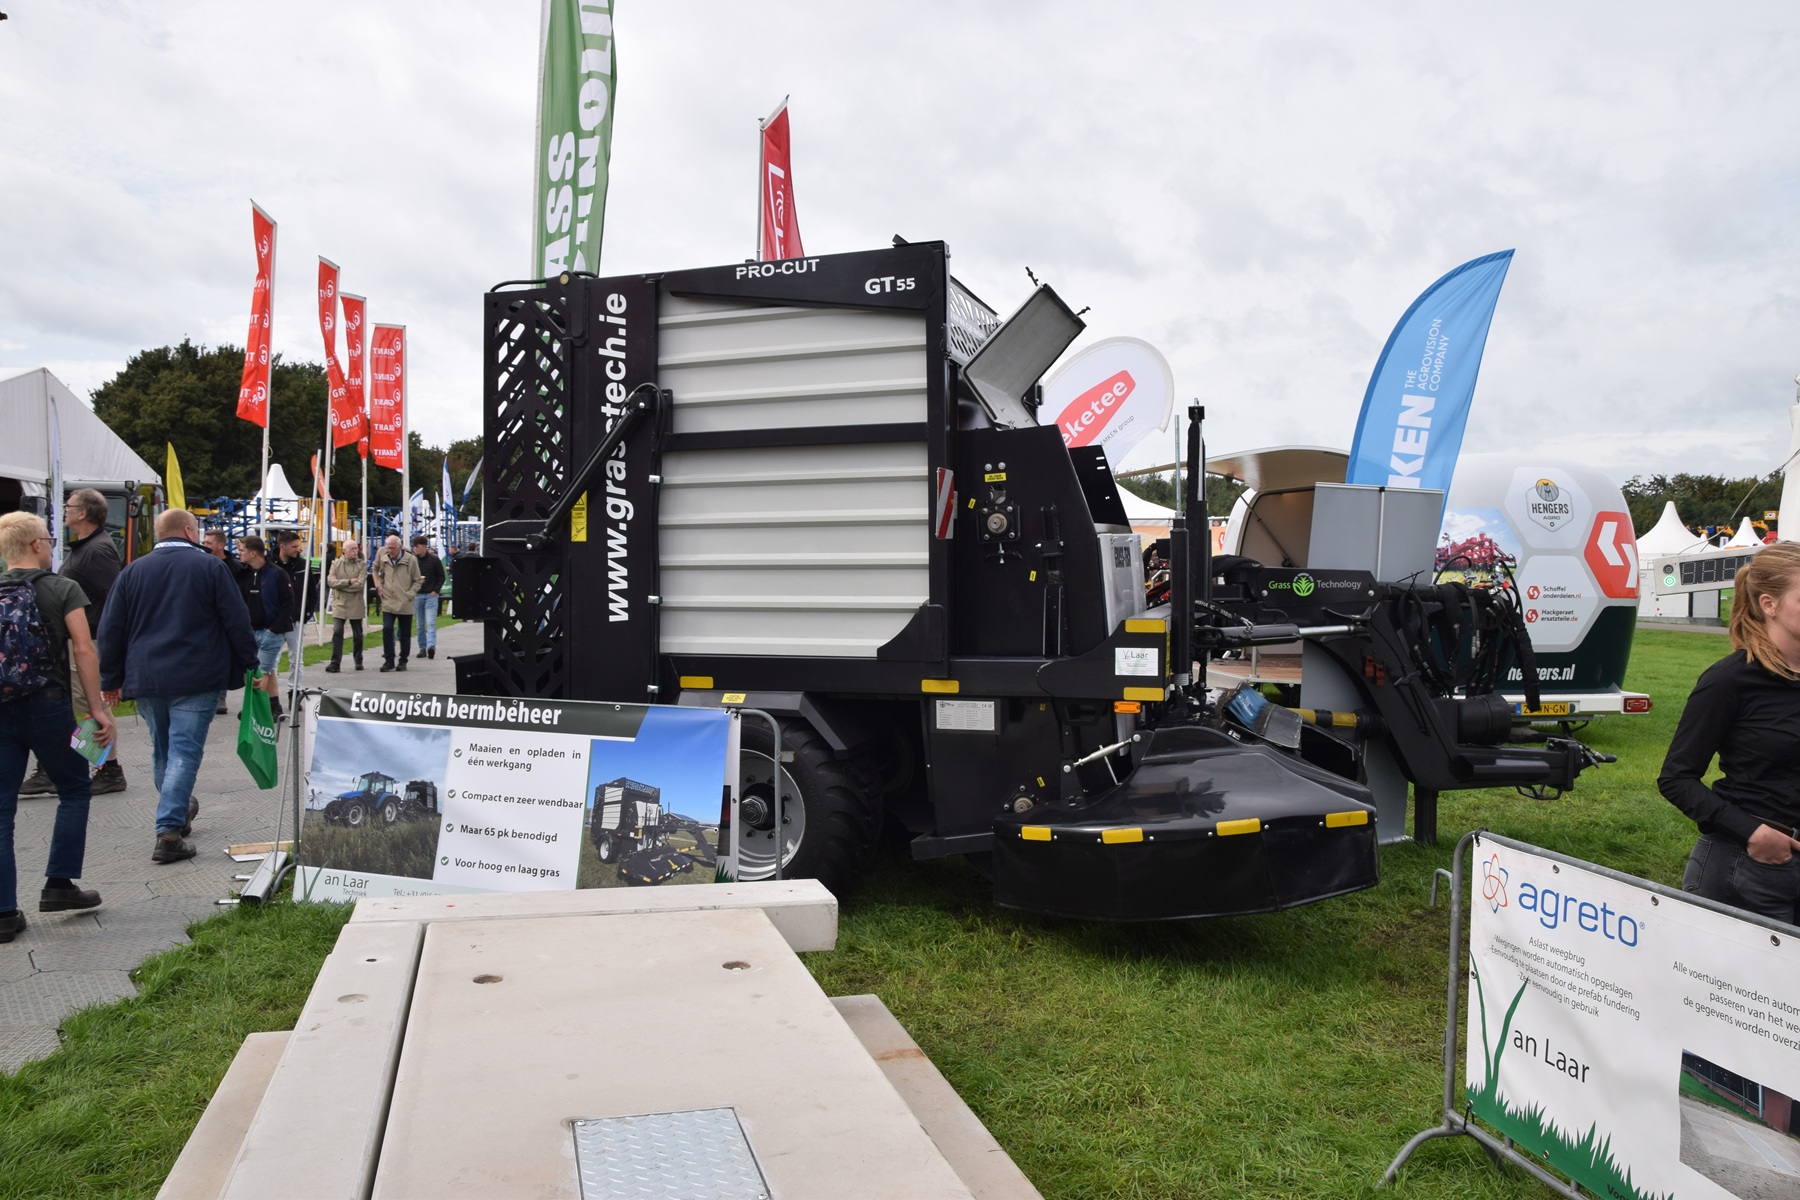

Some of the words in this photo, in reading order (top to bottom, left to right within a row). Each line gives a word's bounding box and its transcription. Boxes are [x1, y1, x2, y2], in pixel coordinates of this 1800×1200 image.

[736, 259, 820, 280] PRO-CUT
[1417, 319, 1442, 390] AGROVISION
[1429, 335, 1449, 391] COMPANY
[1404, 370, 1417, 388] THE
[1062, 381, 1127, 447] eketee
[1118, 415, 1135, 431] group
[1532, 503, 1569, 514] HENGERS
[1268, 580, 1291, 590] Grass
[1317, 579, 1361, 590] Technology
[1507, 664, 1576, 681] heers.nl
[350, 692, 442, 720] Ecologisch
[446, 698, 562, 725] bermbeheer
[469, 743, 502, 754] Maaien
[527, 748, 565, 758] opladen
[572, 750, 581, 759] in
[467, 756, 484, 766] één
[486, 760, 532, 772] werkgang
[461, 790, 502, 803] Compact
[538, 798, 583, 809] wendbaar
[460, 824, 482, 835] Maar
[484, 827, 495, 836] 65
[497, 829, 509, 839] pk
[511, 829, 558, 844] benodigd
[455, 858, 476, 869] Voor
[478, 860, 502, 873] hoog
[504, 865, 516, 873] en
[518, 864, 538, 877] laag
[540, 868, 560, 878] gras
[324, 875, 340, 886] an
[342, 874, 370, 889] Laar
[342, 888, 367, 897] Techniek
[1528, 936, 1549, 952] Aslast
[1550, 946, 1586, 967] weegbrug
[1521, 948, 1545, 965] worden
[1546, 959, 1589, 982] automatisch
[1590, 976, 1633, 1000] opgeslagen
[1672, 961, 1687, 975] Alle
[1688, 968, 1733, 992] voertuigen
[1734, 985, 1770, 1005] worden
[1525, 963, 1549, 981] plaatsen
[1550, 973, 1567, 988] door
[1567, 981, 1577, 993] de
[1578, 986, 1602, 1003] prefab
[1603, 995, 1640, 1021] fundering
[1532, 979, 1562, 1004] eenvoudig
[1563, 994, 1570, 1005] in
[1571, 999, 1600, 1018] gebruik
[1683, 996, 1693, 1007] de
[1695, 1001, 1733, 1025] gegevens
[1734, 1019, 1770, 1039] worden
[1709, 992, 1745, 1013] passeren
[1747, 1007, 1766, 1020] van
[1768, 1011, 1784, 1027] het
[1513, 1030, 1537, 1057] an
[1544, 1038, 1590, 1083] Laar
